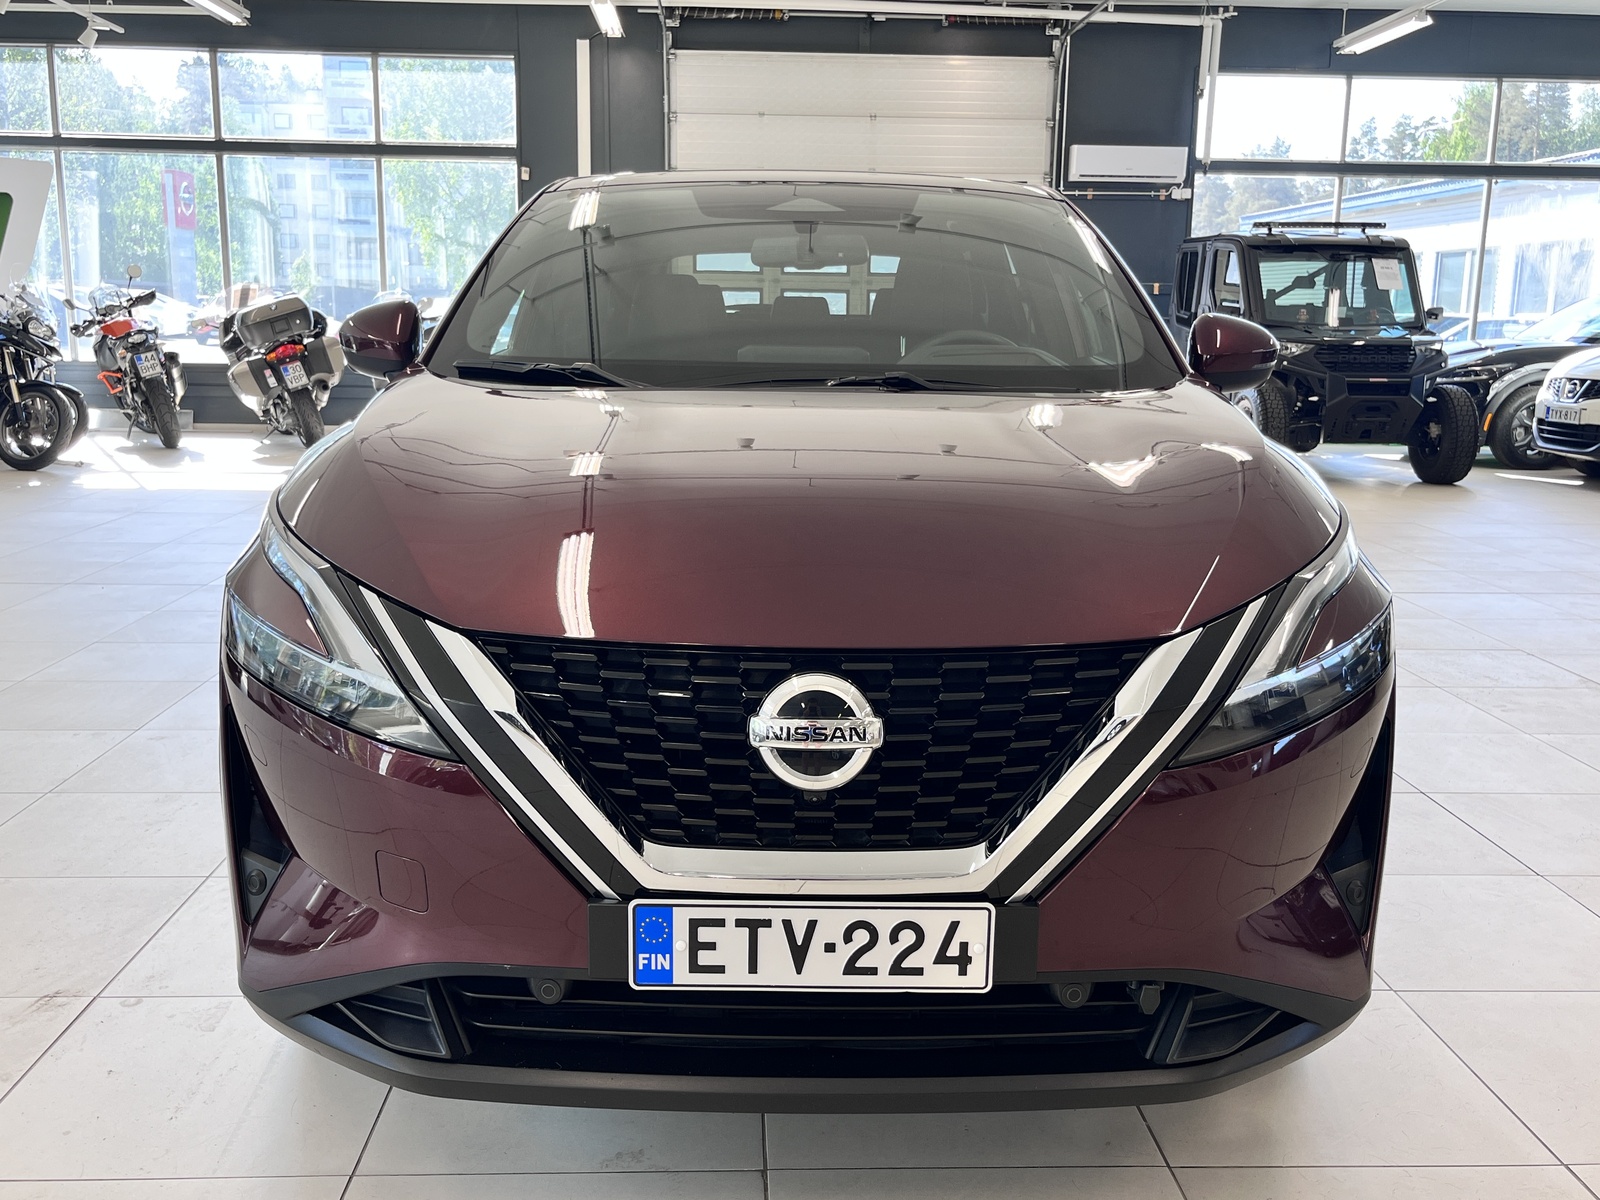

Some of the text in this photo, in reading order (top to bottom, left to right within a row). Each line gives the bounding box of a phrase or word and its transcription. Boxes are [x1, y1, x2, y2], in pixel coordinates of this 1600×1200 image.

[140, 362, 159, 374] BHP
[289, 364, 302, 375] 30
[287, 373, 305, 385] VBP
[765, 725, 867, 742] NISSAN
[688, 917, 972, 976] ETV-224
[638, 953, 670, 971] FIN
